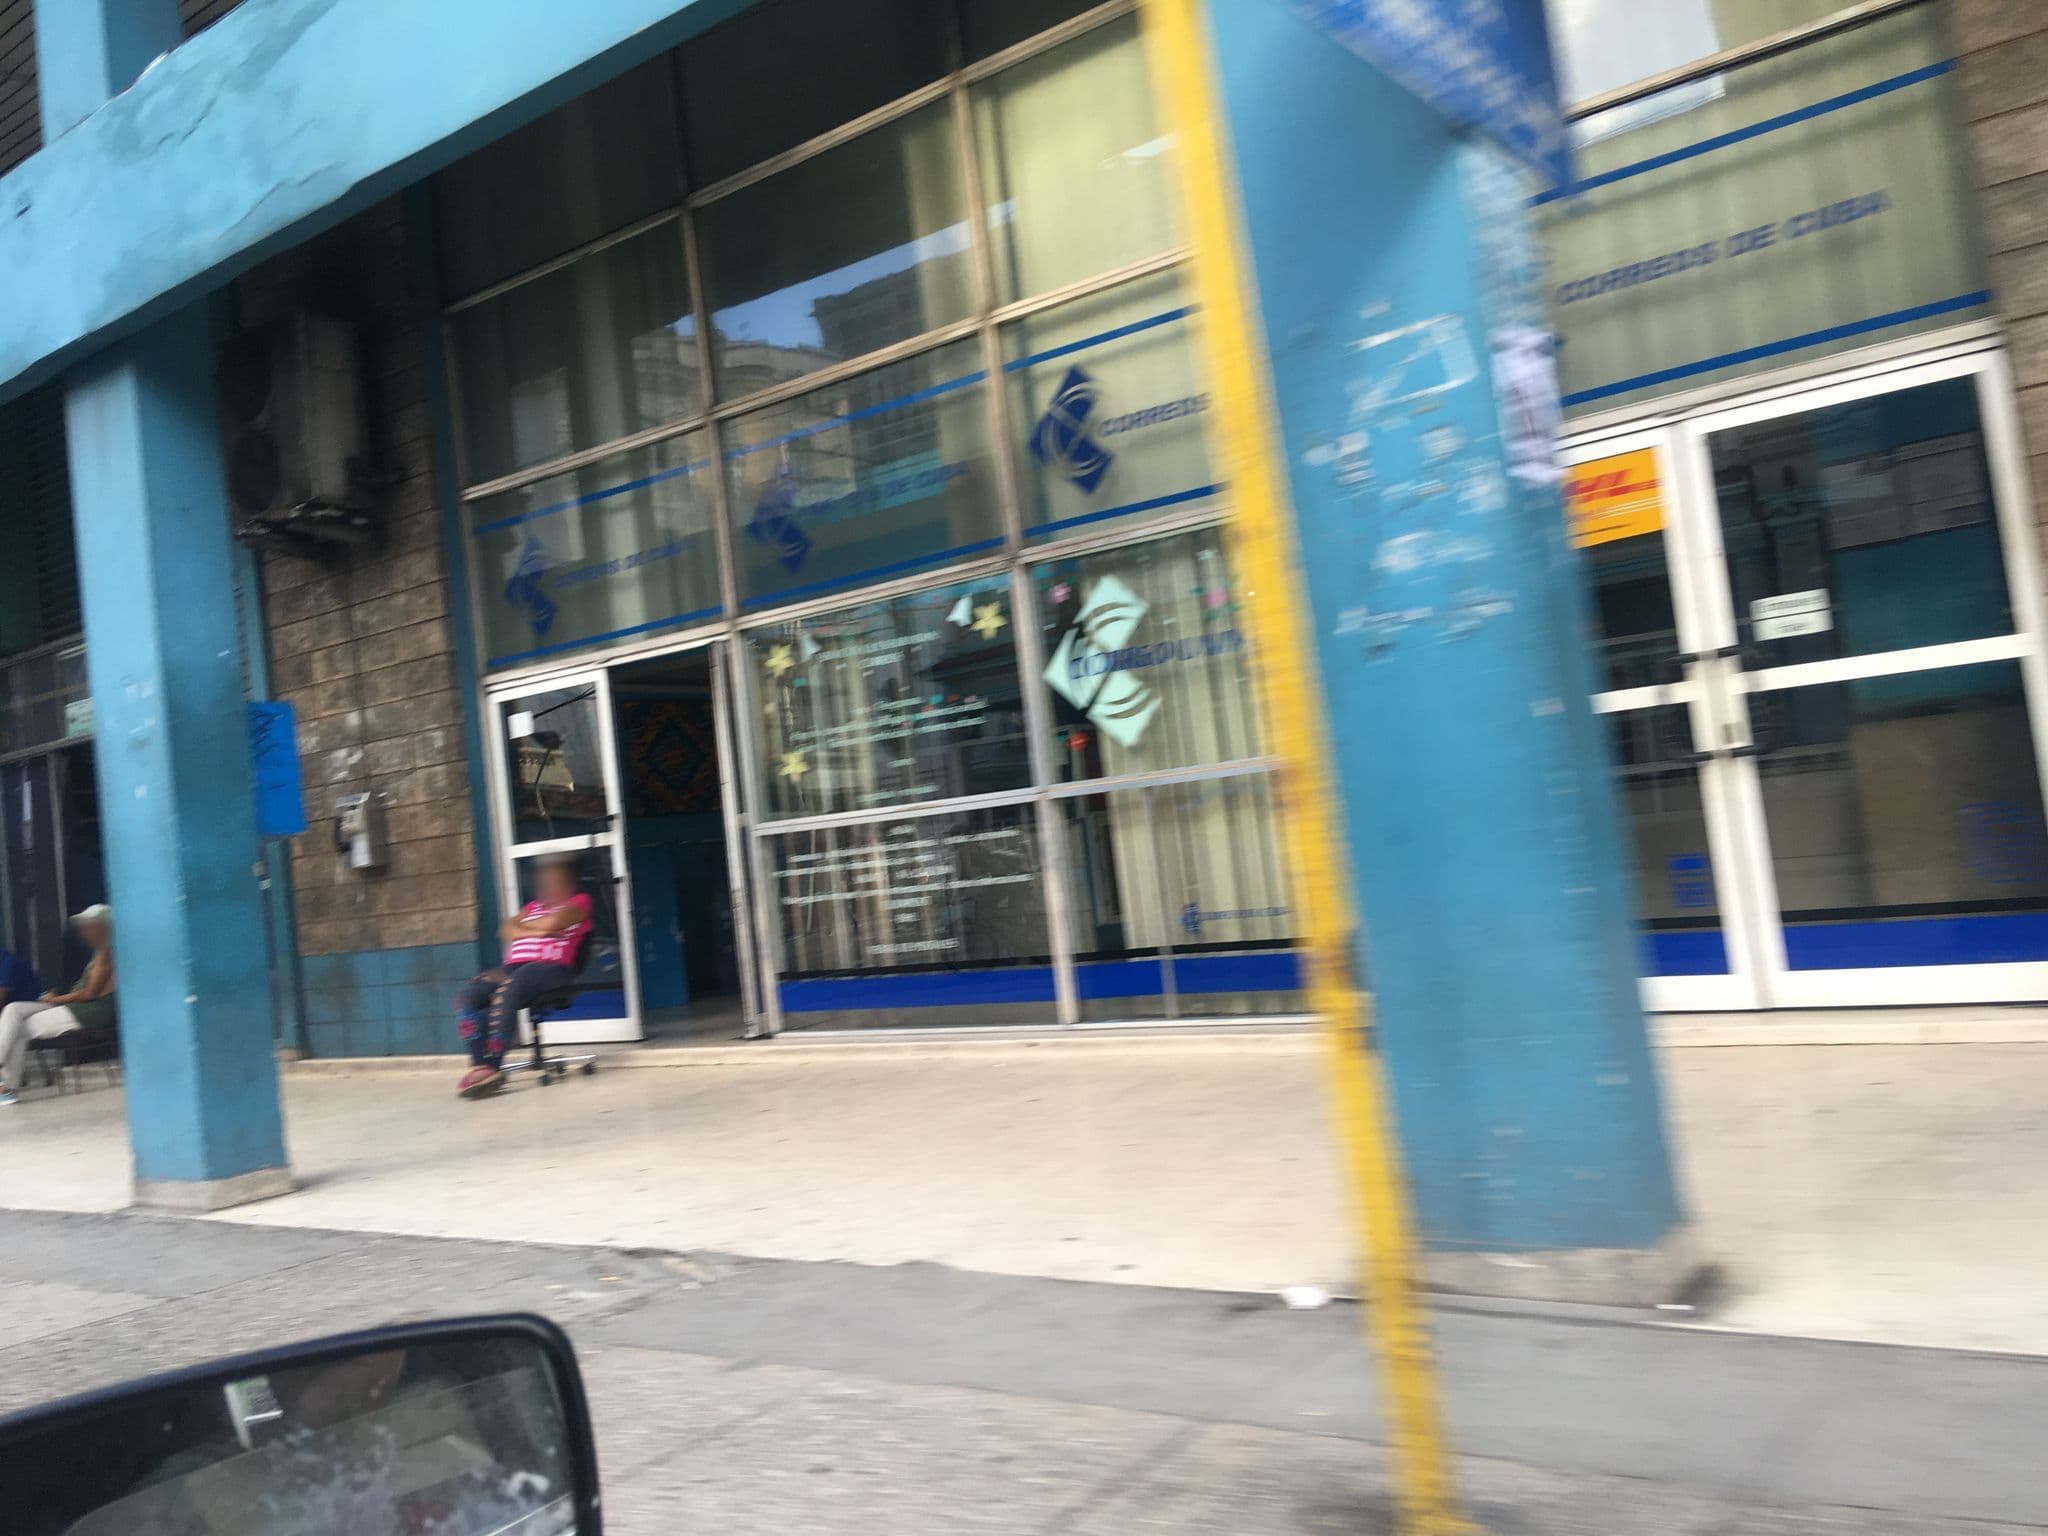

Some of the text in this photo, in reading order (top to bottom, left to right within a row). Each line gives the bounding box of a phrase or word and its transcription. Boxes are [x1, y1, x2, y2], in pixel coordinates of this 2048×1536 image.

[1557, 188, 1891, 305] CORREOS DE CUBA
